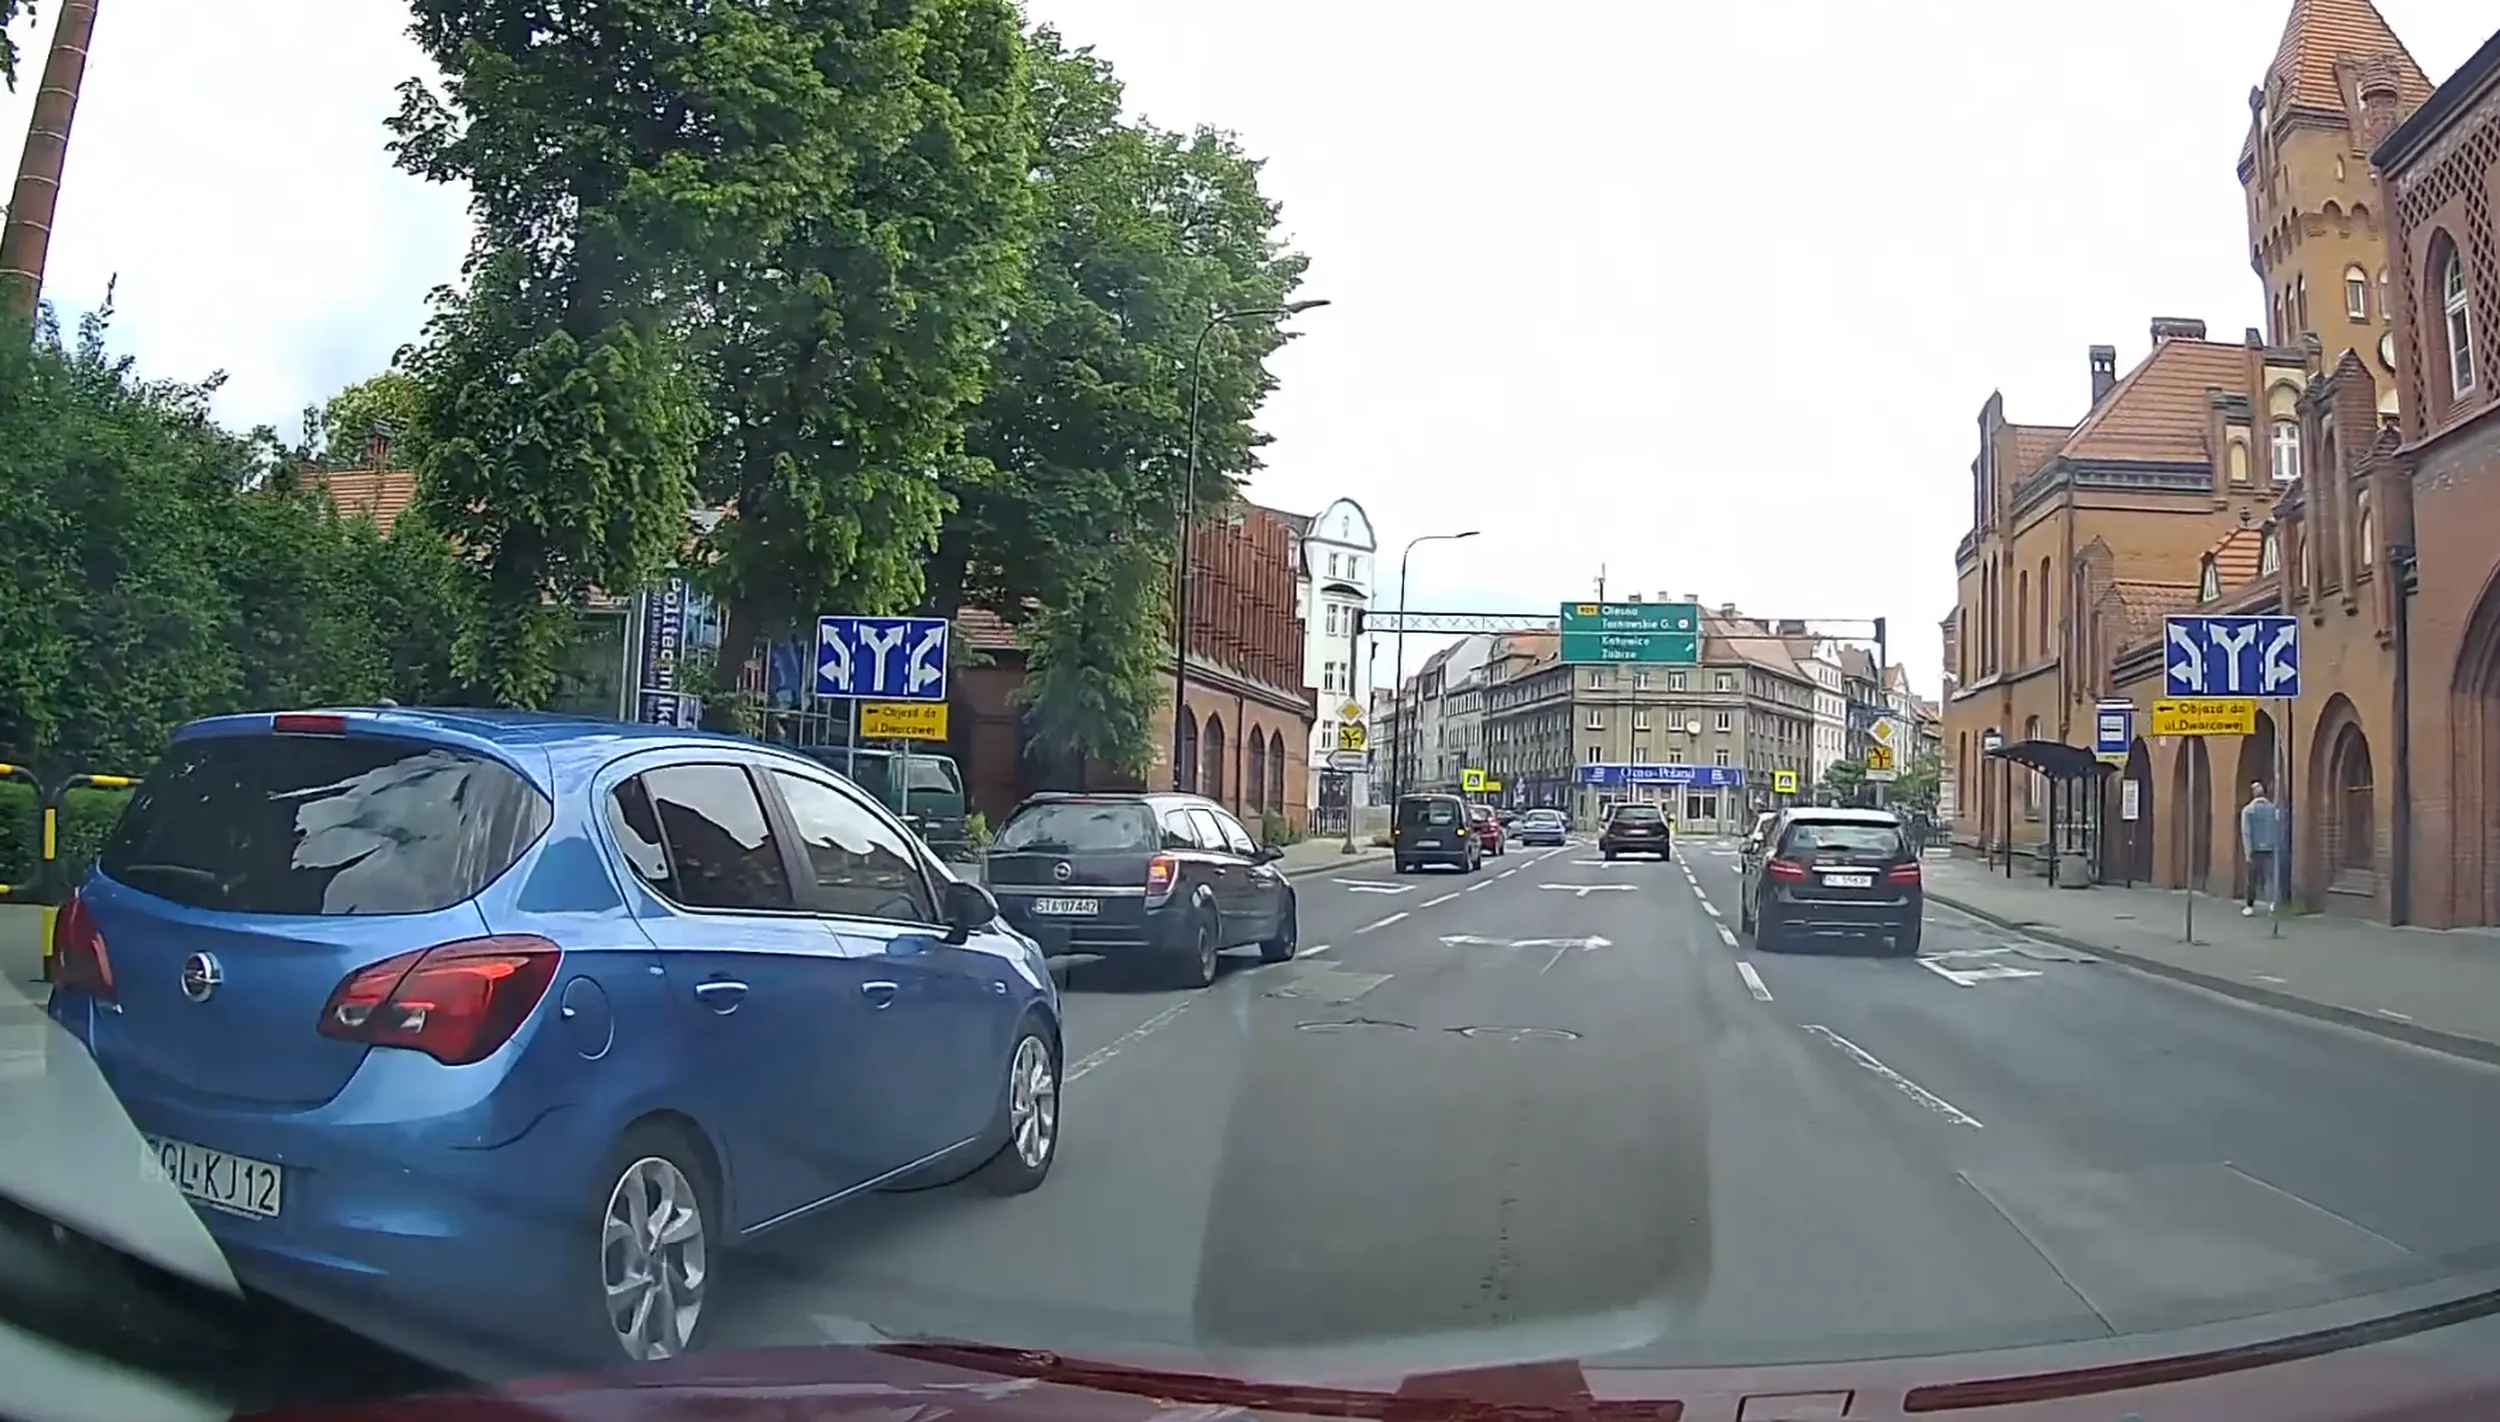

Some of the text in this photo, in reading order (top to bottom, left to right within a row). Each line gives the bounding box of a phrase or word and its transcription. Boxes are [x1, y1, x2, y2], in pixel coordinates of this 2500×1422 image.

[1601, 605, 1638, 616] Olesno
[1601, 635, 1650, 647] Katowice
[1601, 649, 1637, 659] Zabrze
[2179, 703, 2245, 716] Objazd do
[204, 1153, 275, 1212] KJ12
